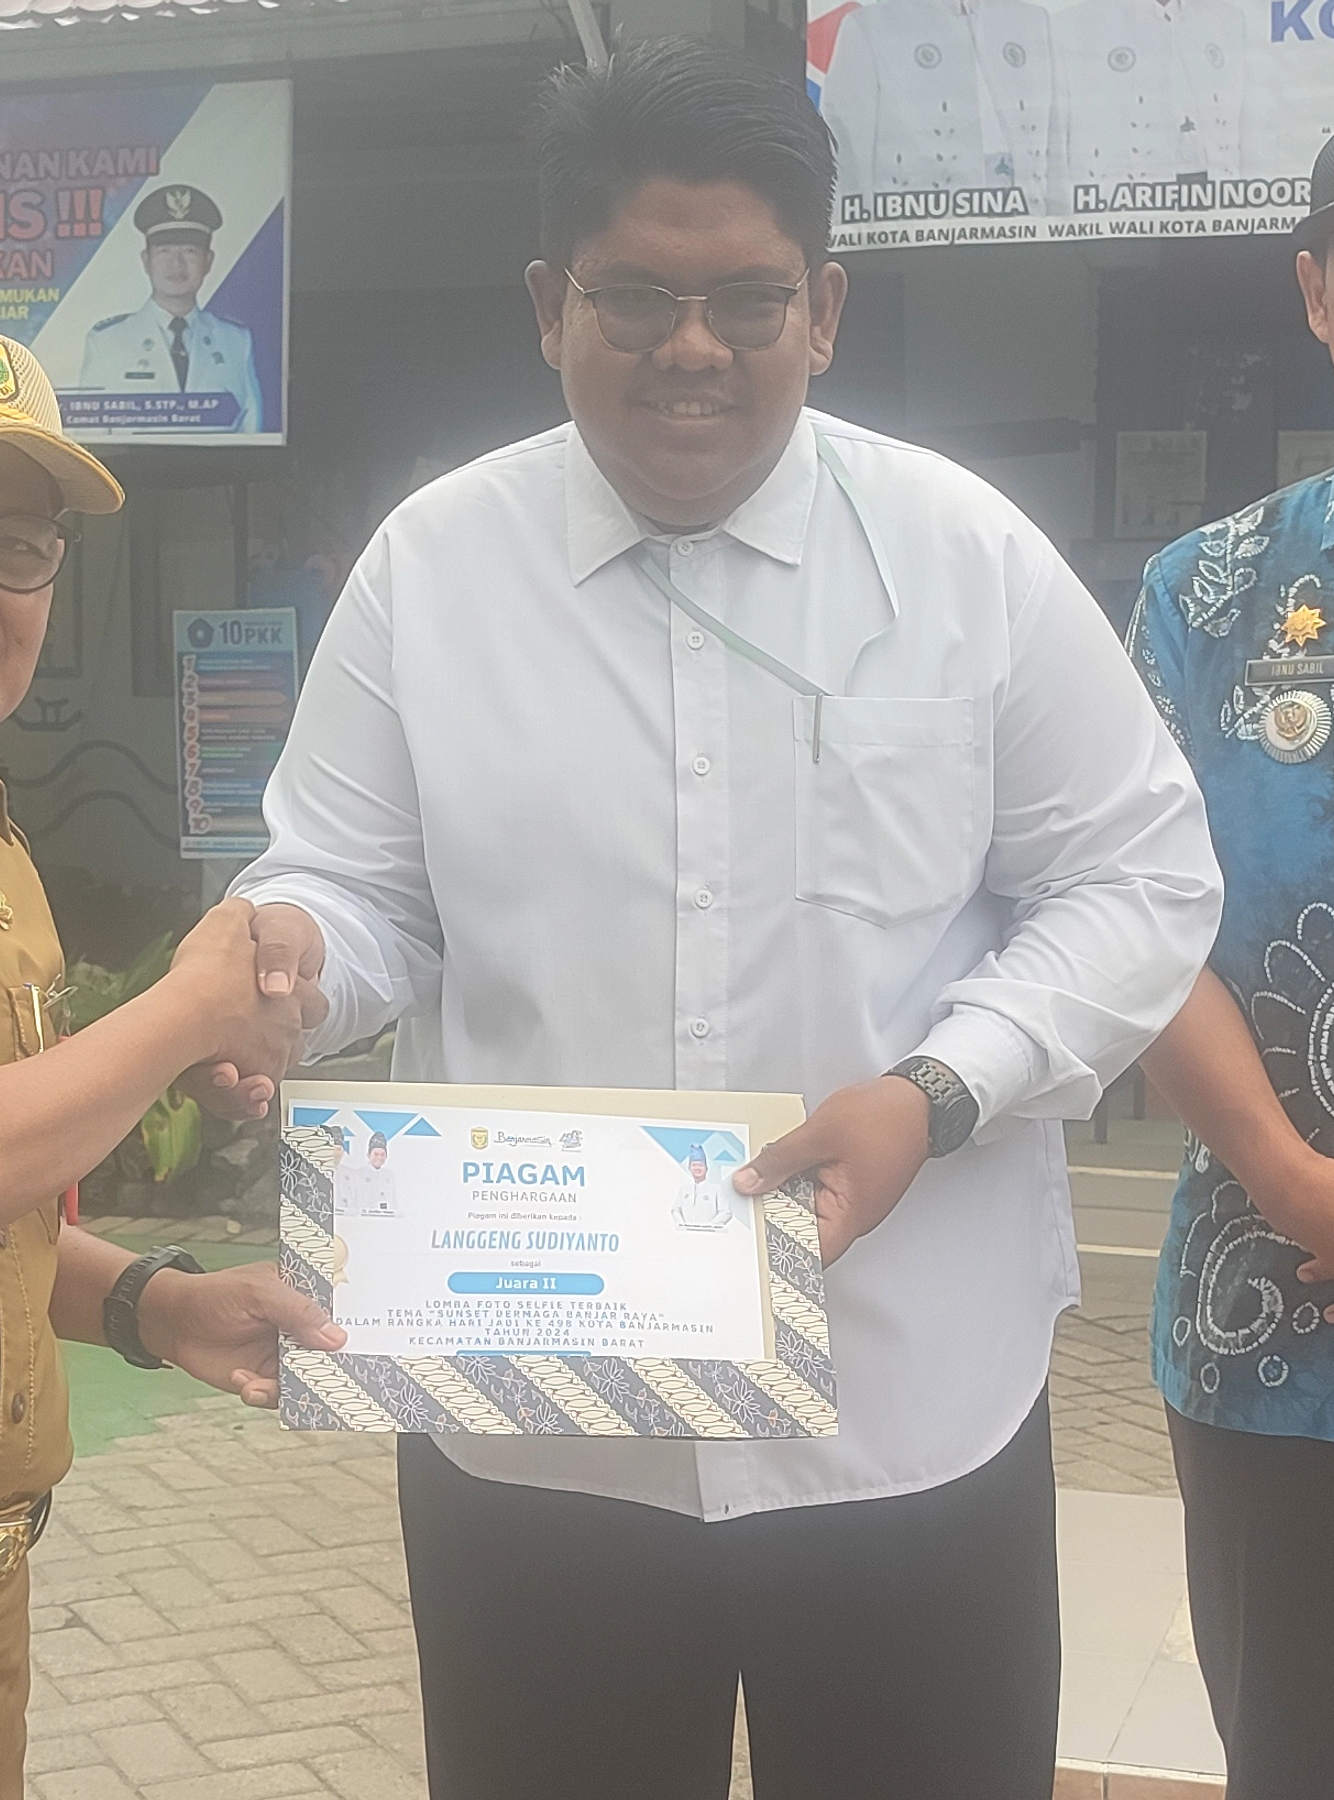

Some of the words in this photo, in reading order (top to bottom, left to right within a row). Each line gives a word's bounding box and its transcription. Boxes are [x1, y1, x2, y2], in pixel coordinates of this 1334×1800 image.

[67, 147, 159, 179] KAMI
[1075, 185, 1106, 213] H.
[1114, 179, 1213, 210] ARIFIN
[1220, 178, 1310, 206] NOOR
[843, 196, 871, 222] H.
[876, 190, 948, 219] IBNU
[954, 188, 1026, 216] SINA
[56, 188, 105, 238] !!!
[1048, 221, 1103, 238] WAKIL
[1110, 220, 1154, 236] WALI
[1160, 218, 1206, 234] KOTA
[829, 231, 862, 249] ALI
[867, 228, 911, 245] KOTA
[915, 224, 1037, 247] BANJARMASIN
[70, 401, 100, 411] IBNU
[66, 416, 99, 424] Camat
[103, 415, 168, 426] Banjarmasin
[171, 414, 201, 423] Barat
[219, 620, 243, 645] 10
[244, 627, 283, 645] PKK
[1296, 661, 1324, 675] SABIL
[462, 1161, 585, 1187] PIAGAM
[472, 1190, 577, 1203] PENGHARGAAN
[468, 1212, 497, 1220] Piagam
[510, 1212, 547, 1220] diberikan
[549, 1213, 577, 1222] kepada
[431, 1229, 521, 1250] LANGGENG
[526, 1231, 619, 1253] SUDIYANTO
[510, 1259, 541, 1268] sebagai
[495, 1276, 538, 1290] Juara
[542, 1277, 556, 1290] II
[425, 1300, 471, 1309] LOMBA
[477, 1300, 511, 1309] FOTO
[517, 1301, 563, 1310] SELFIE
[570, 1301, 627, 1311] TERBAIK
[387, 1309, 423, 1318] TEMA
[496, 1310, 560, 1319] DERMAGA
[566, 1310, 617, 1320] BANJAR
[336, 1317, 381, 1326] DALAM
[388, 1318, 442, 1327] RANGKA
[448, 1319, 482, 1327] HARI
[488, 1319, 520, 1327] JADI
[527, 1319, 542, 1327] KE
[548, 1320, 573, 1328] 498
[578, 1320, 613, 1329] KOTA
[619, 1321, 714, 1333] BANJARMASIN
[485, 1328, 530, 1336] TAHUN
[537, 1329, 570, 1337] 2024
[409, 1337, 492, 1346] KECAMATAN
[499, 1337, 595, 1347] BANJARMASIN
[602, 1338, 645, 1348] BARAT
